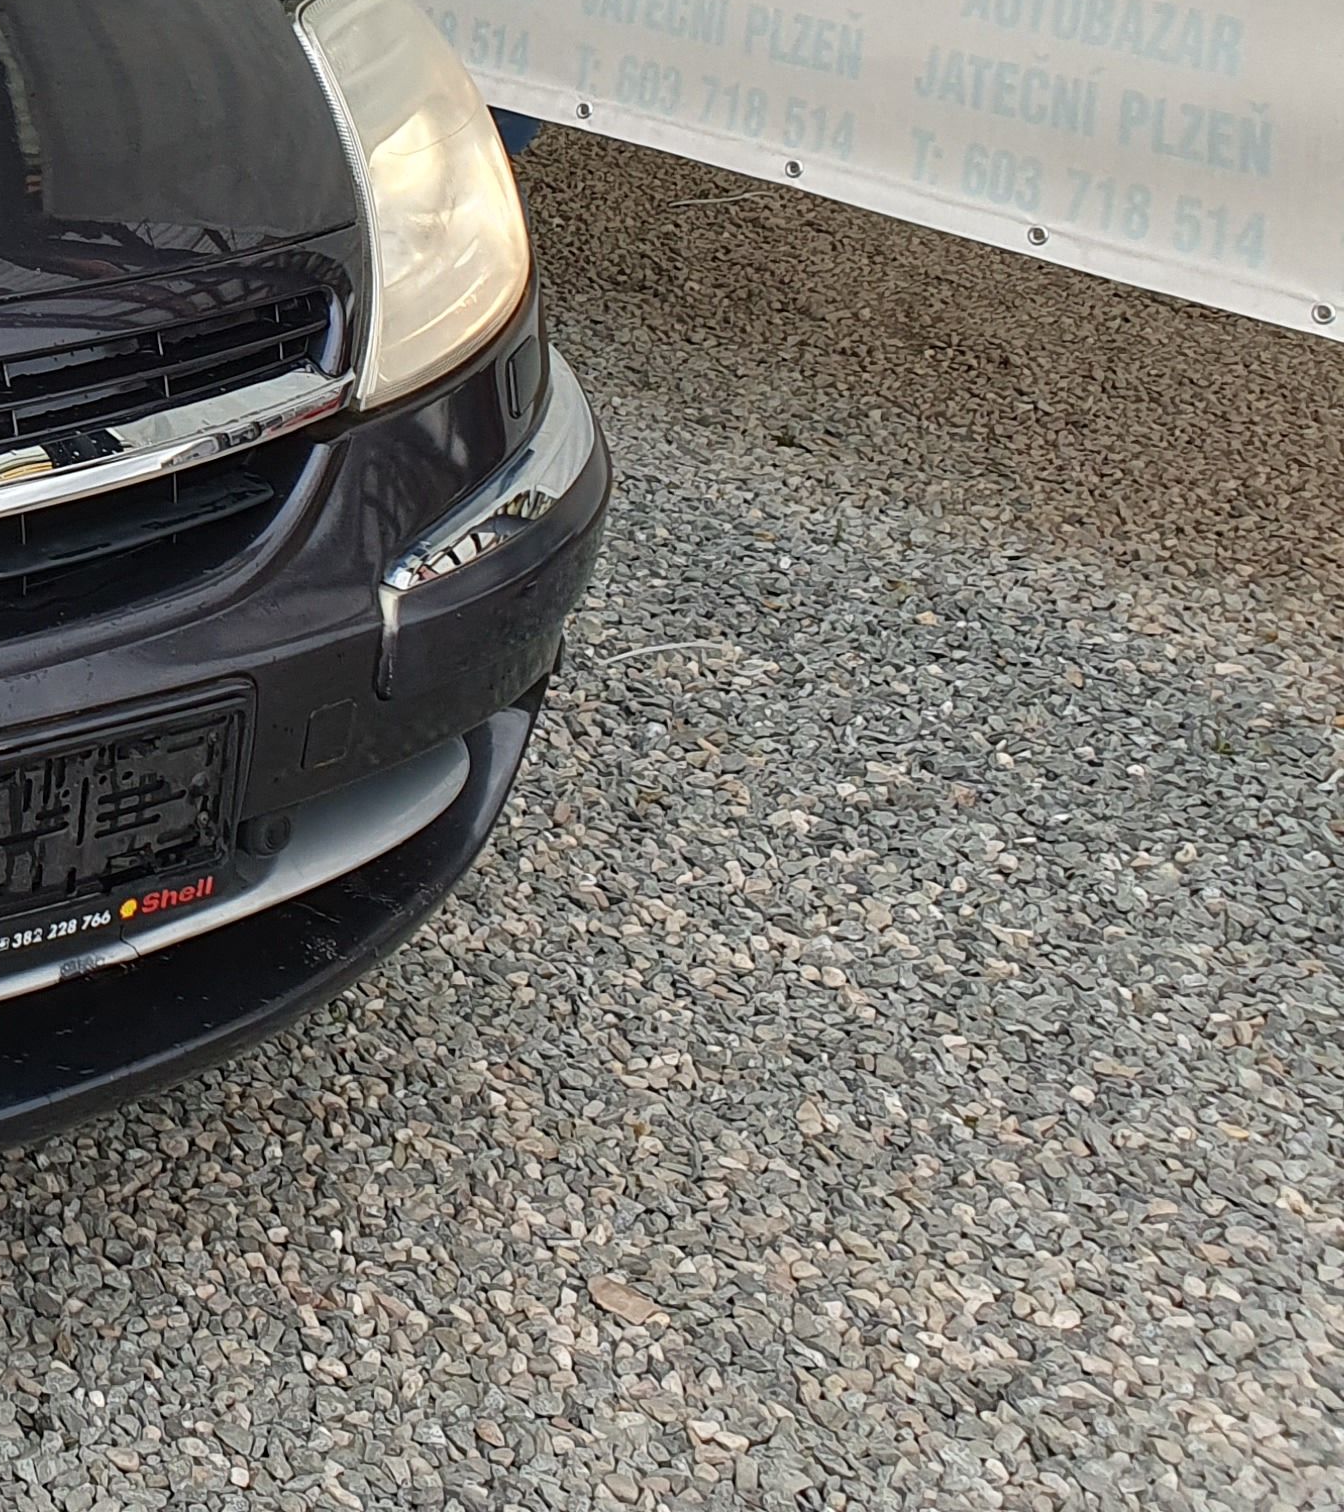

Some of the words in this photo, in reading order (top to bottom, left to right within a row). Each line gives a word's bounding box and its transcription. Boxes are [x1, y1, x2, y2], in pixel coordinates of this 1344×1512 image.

[470, 17, 529, 76] 514
[742, 2, 862, 81] PLZEŇ
[913, 43, 1107, 138] JATEČNÍ
[1118, 88, 1275, 179] PLZEŇ
[963, 141, 1044, 214] 603
[1065, 166, 1152, 241] 718
[1172, 192, 1267, 271] 514
[11, 928, 43, 949] 382
[47, 919, 77, 940] 228
[81, 910, 111, 931] 766
[142, 876, 213, 914] Shell
